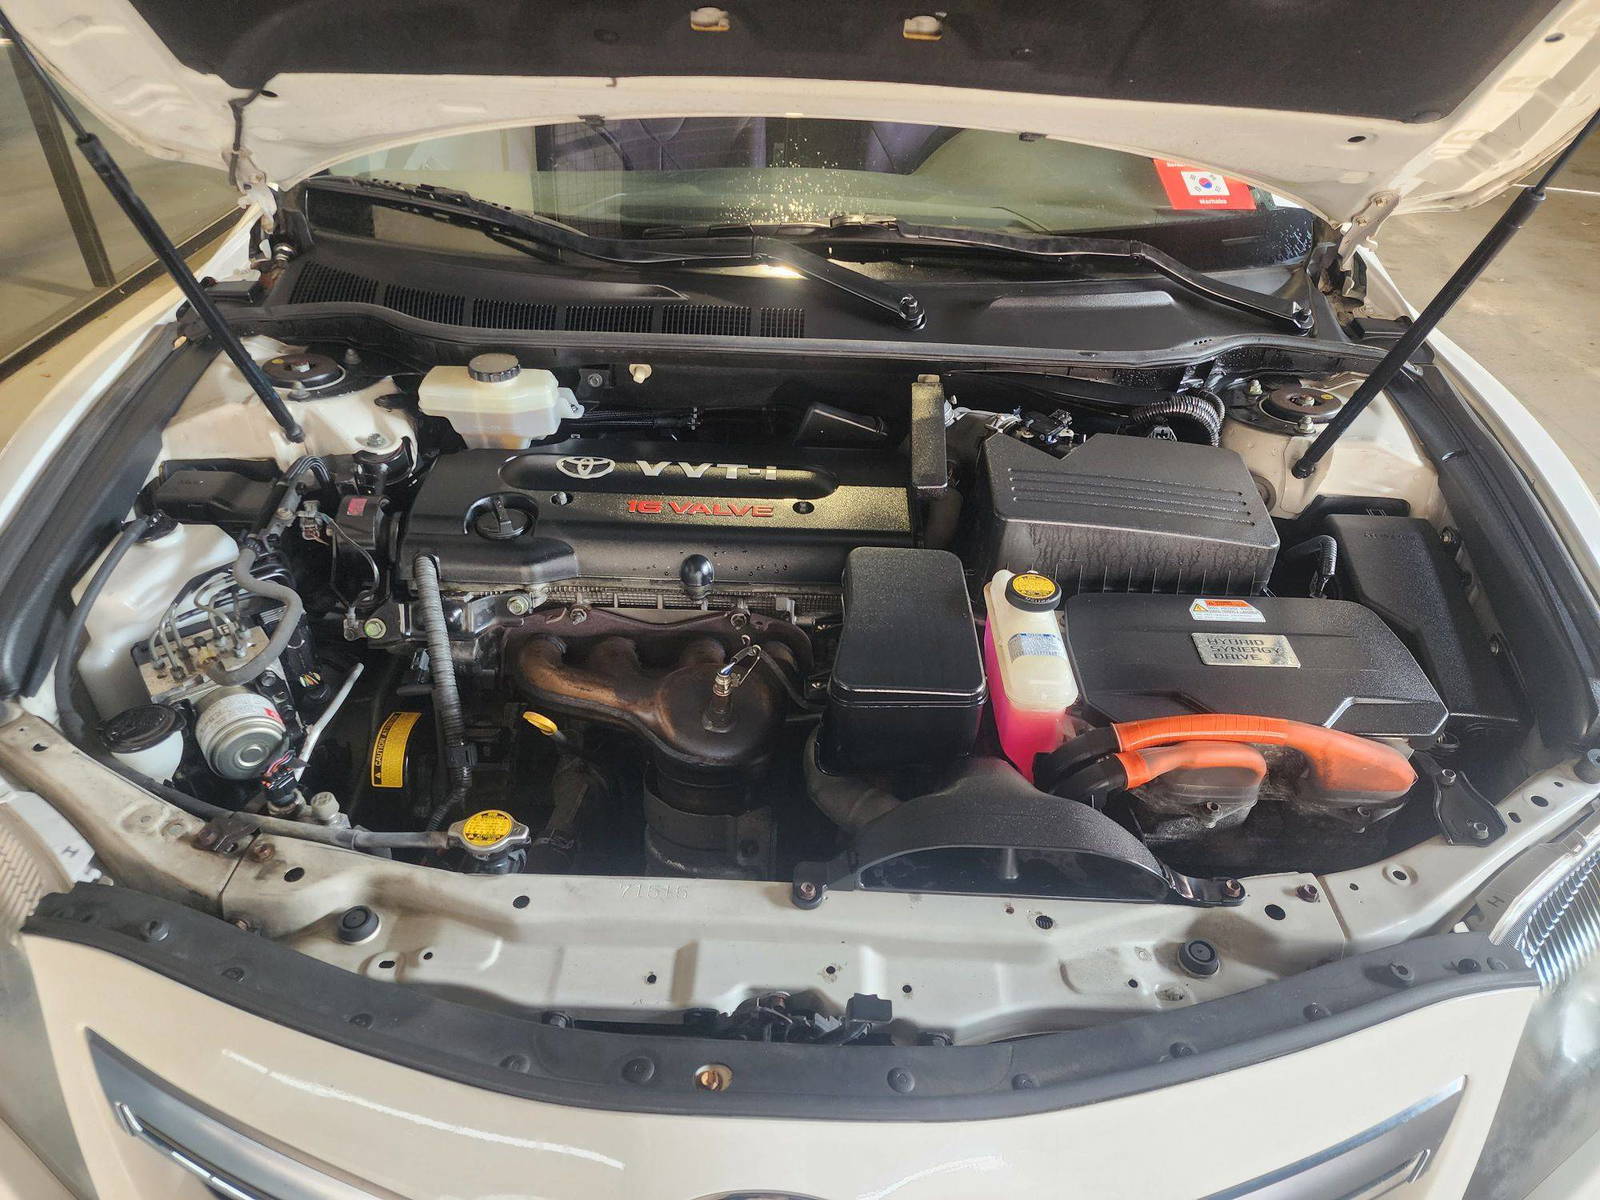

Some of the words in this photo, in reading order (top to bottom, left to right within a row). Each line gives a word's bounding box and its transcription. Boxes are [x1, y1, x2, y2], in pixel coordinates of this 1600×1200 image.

[627, 499, 662, 514] 16
[667, 501, 775, 517] VALVE
[1207, 638, 1265, 646] HYBRID
[1210, 645, 1281, 654] SYNERGY
[1213, 653, 1261, 661] DRIVE
